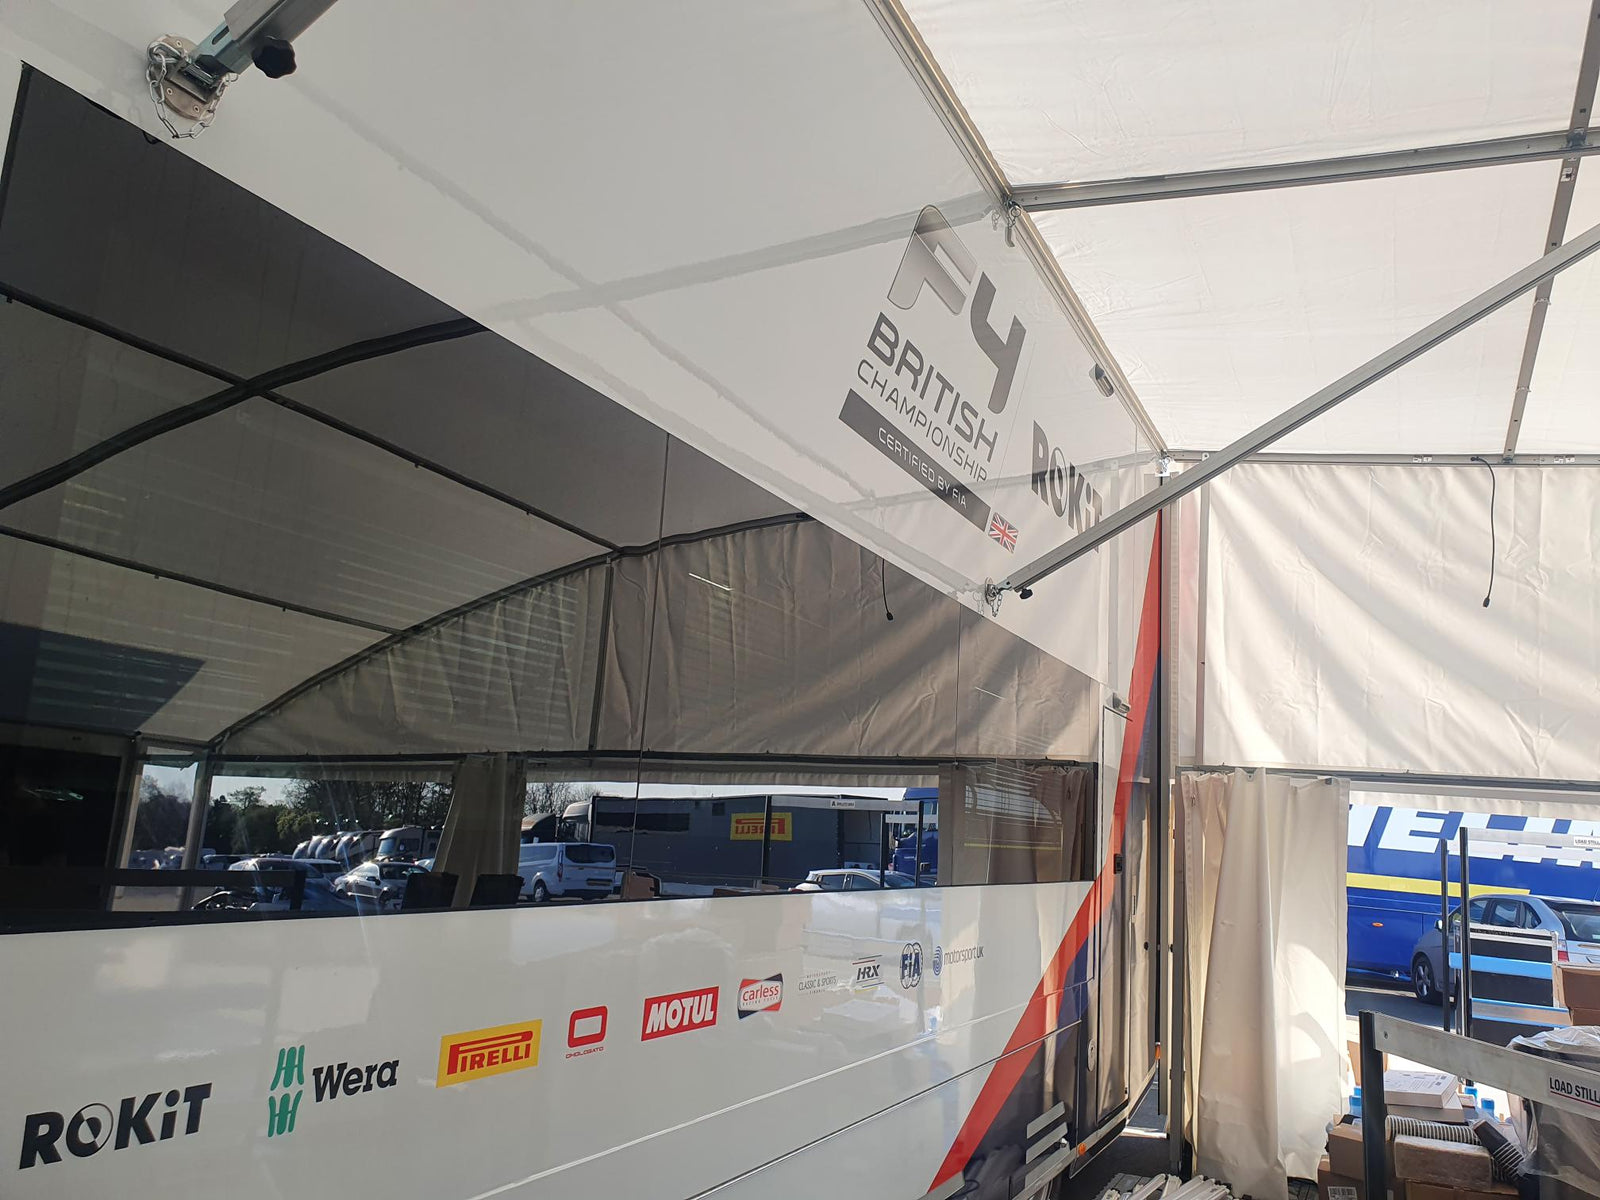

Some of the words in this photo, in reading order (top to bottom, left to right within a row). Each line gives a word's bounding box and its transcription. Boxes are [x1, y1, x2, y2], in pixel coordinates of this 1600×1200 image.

[887, 204, 1027, 415] F4
[867, 311, 998, 463] BRITISH
[857, 358, 988, 484] CHAMPIONSHIP
[877, 426, 936, 484] CERTIFIED
[936, 474, 951, 495] BY
[952, 487, 968, 509] FIA
[742, 984, 780, 1002] carless
[856, 964, 881, 981] HRX
[645, 993, 714, 1034] MOTUL
[446, 1030, 534, 1076] PIRELLI
[312, 1059, 400, 1103] Wera
[1549, 1076, 1573, 1095] LOAD
[1574, 1084, 1600, 1104] STILL
